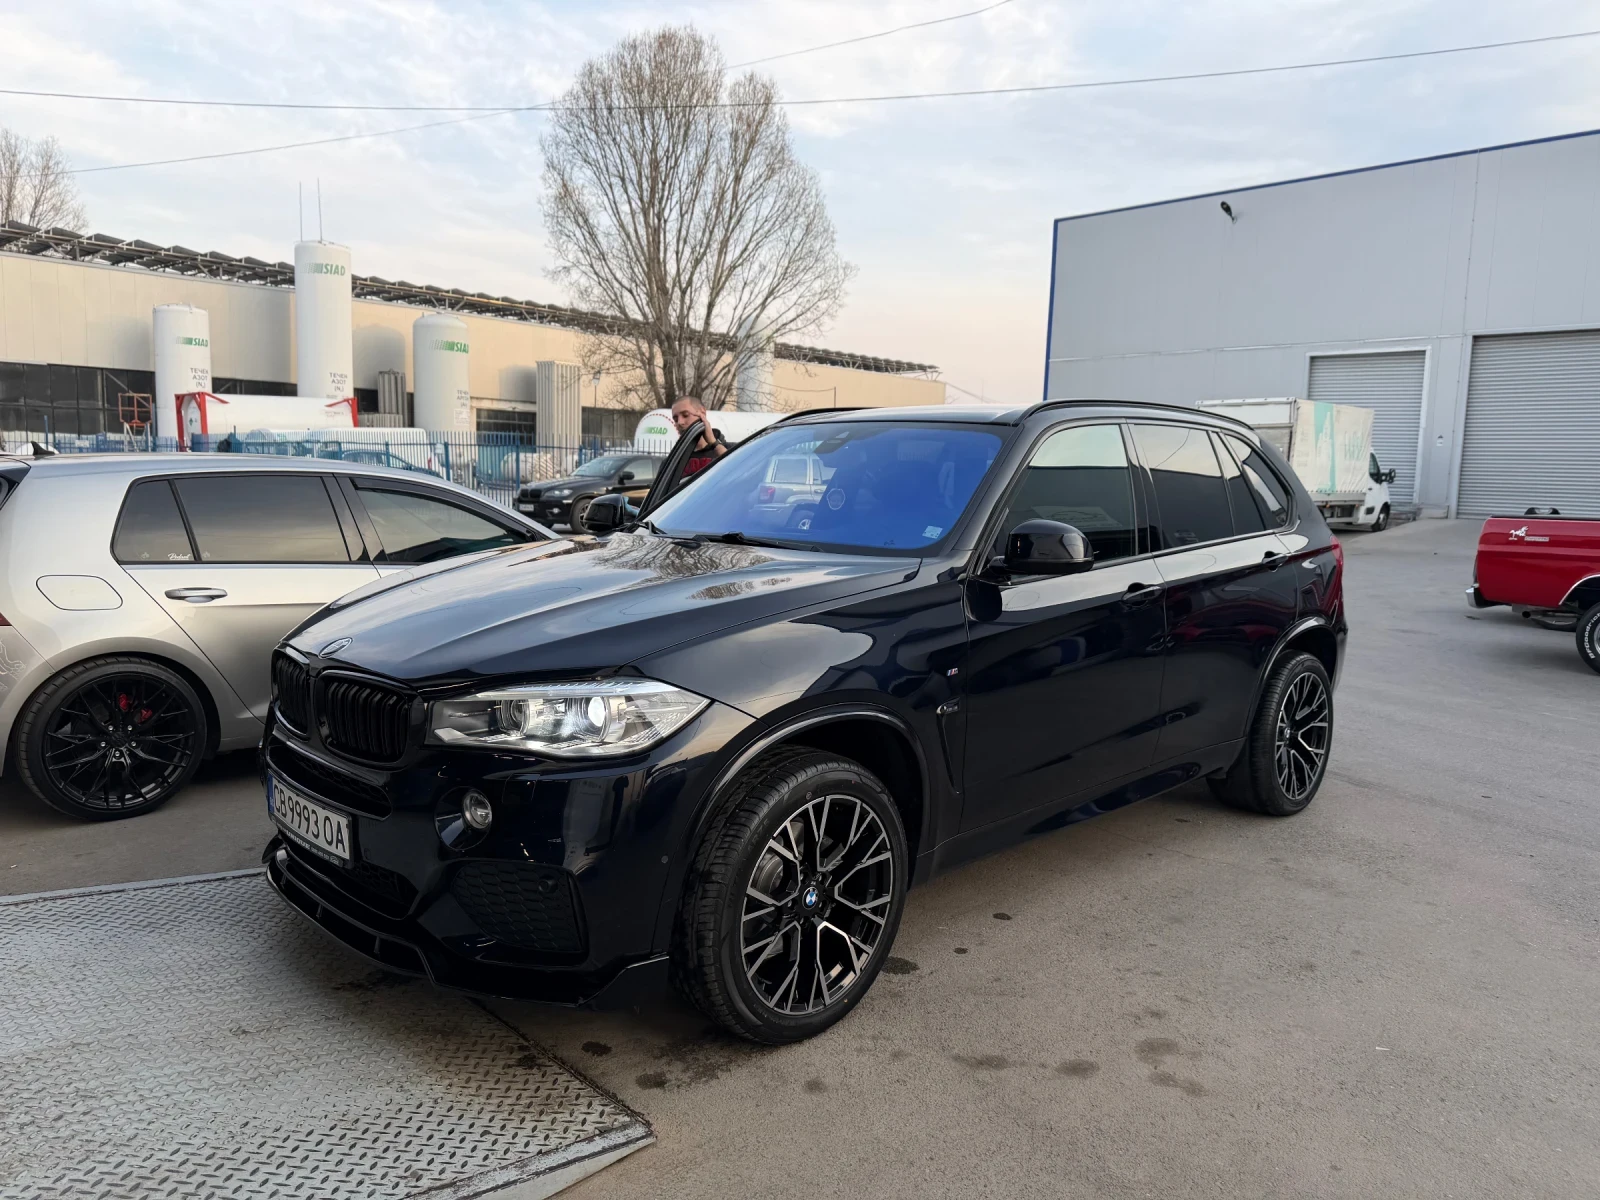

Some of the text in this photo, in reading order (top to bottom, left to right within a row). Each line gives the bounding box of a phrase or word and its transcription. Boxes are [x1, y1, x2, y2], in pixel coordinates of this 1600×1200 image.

[324, 263, 346, 277] SIAD
[193, 337, 209, 348] SIAD
[651, 426, 668, 435] SIAD
